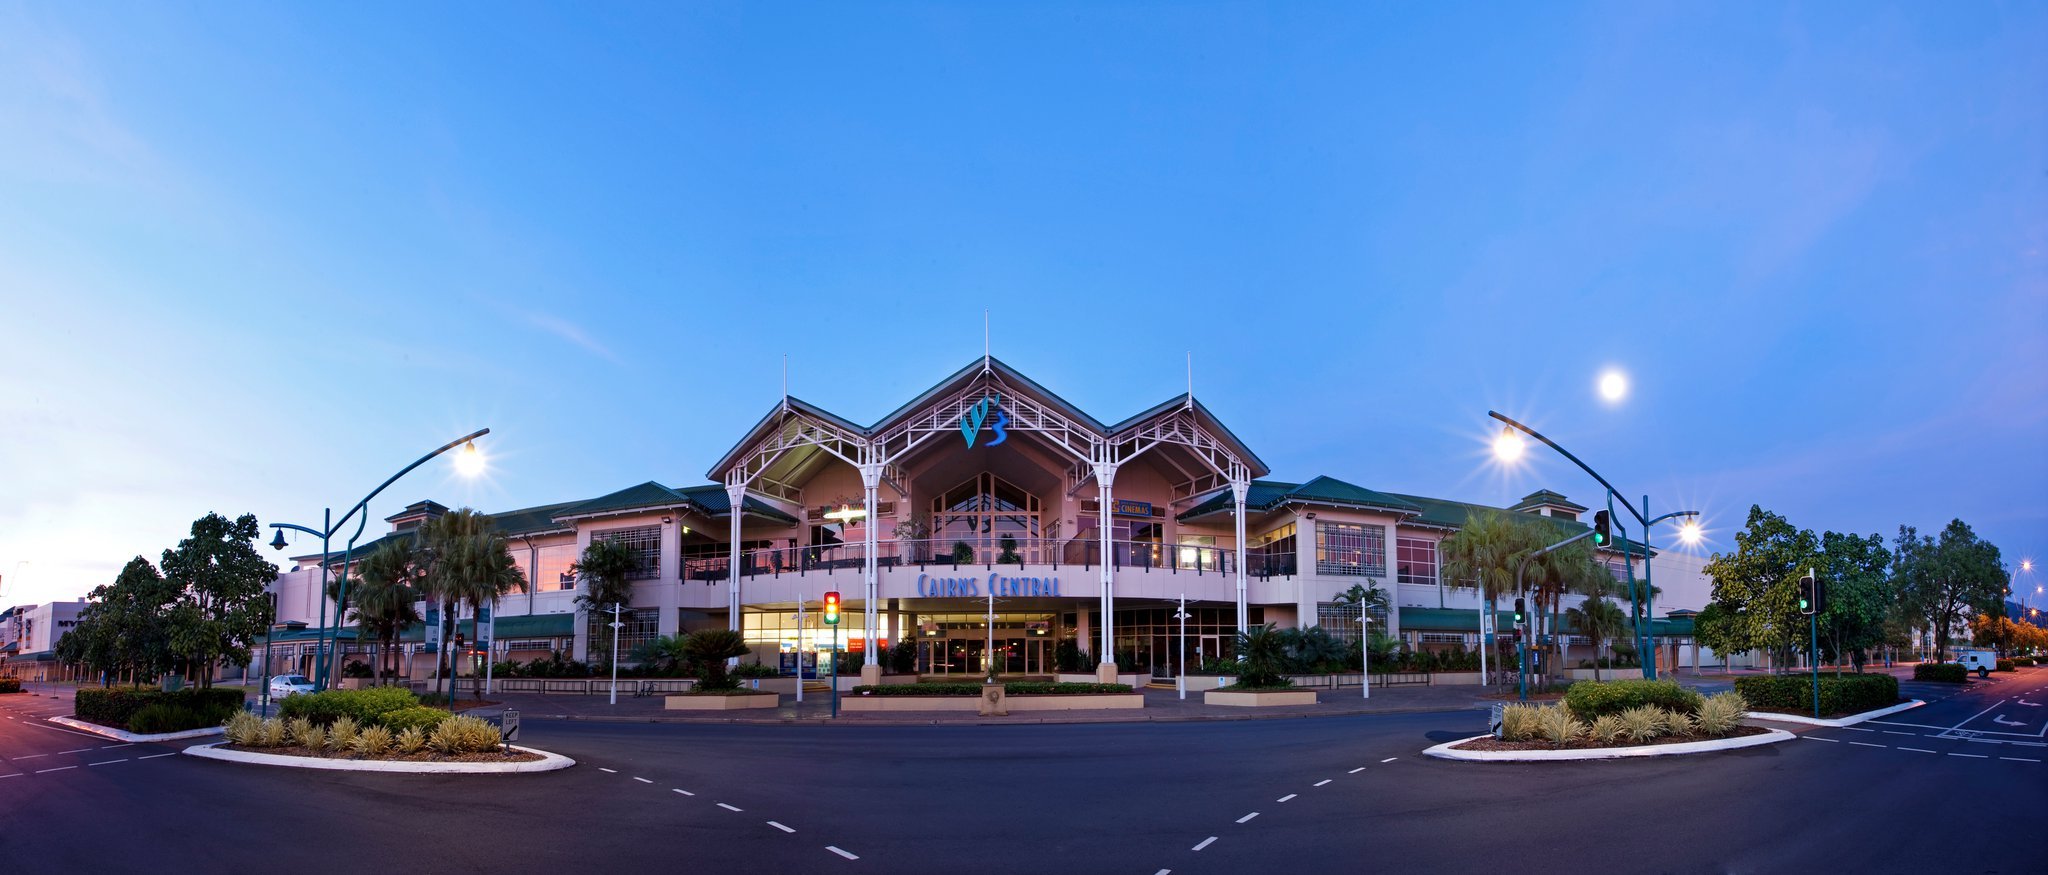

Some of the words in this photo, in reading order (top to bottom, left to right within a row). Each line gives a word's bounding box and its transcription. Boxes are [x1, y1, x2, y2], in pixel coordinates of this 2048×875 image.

[1121, 504, 1149, 515] CINEMAS
[918, 573, 978, 597] CAIRNS
[988, 573, 1061, 597] CENTRAL
